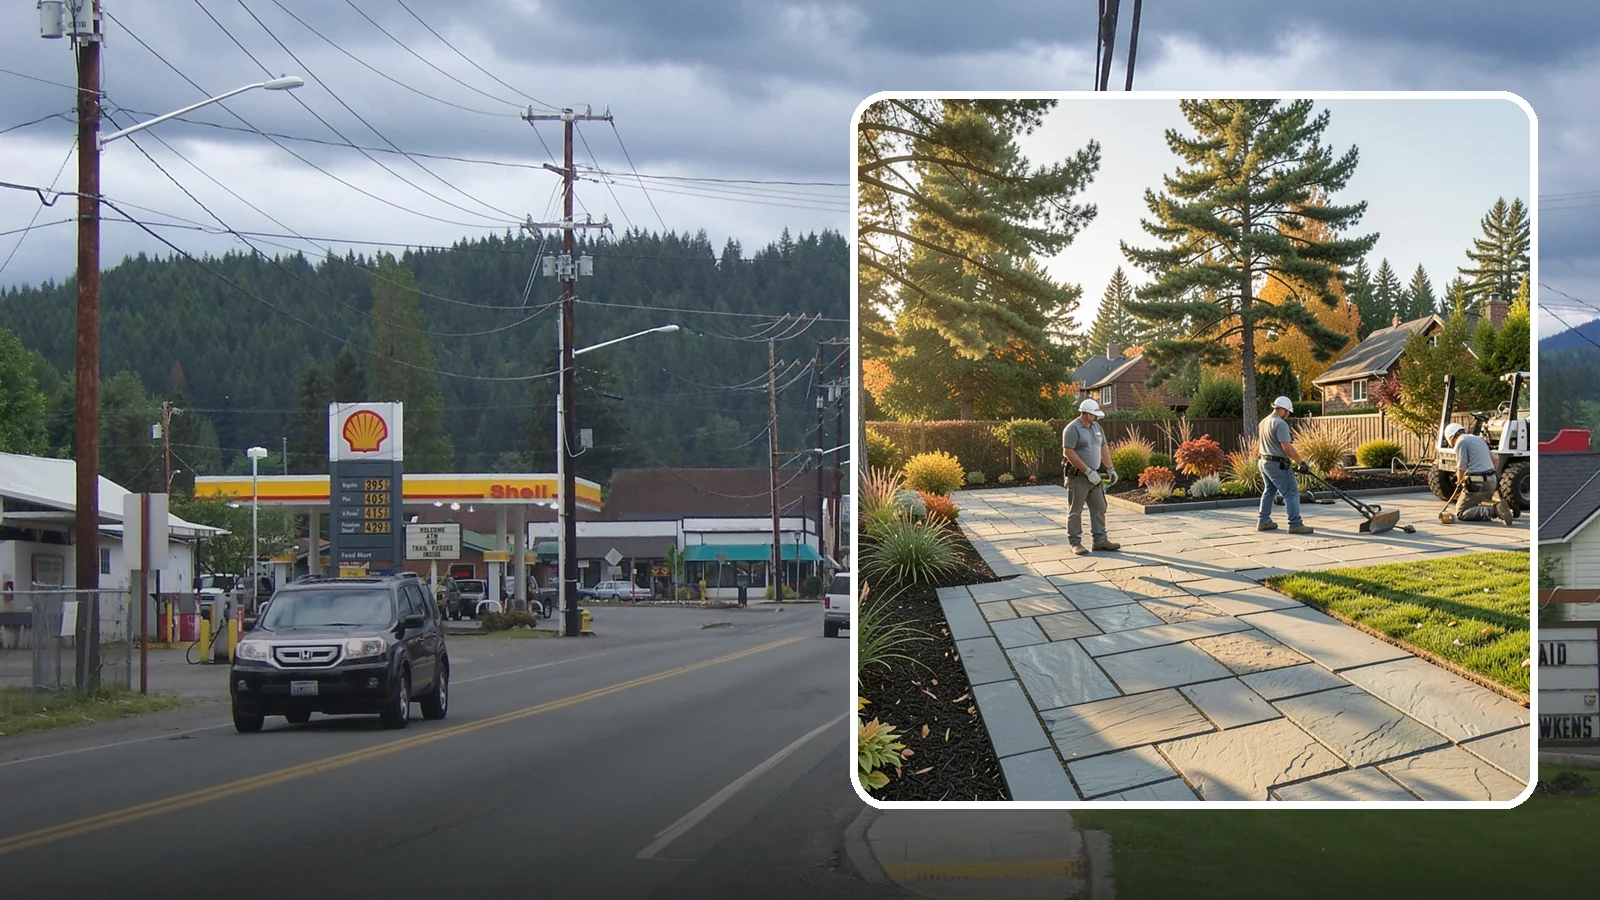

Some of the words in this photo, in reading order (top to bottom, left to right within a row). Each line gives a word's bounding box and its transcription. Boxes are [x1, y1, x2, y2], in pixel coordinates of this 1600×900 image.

[365, 480, 384, 490] 395
[490, 484, 547, 499] Shell
[365, 494, 384, 504] 405
[365, 508, 384, 518] 415
[365, 522, 384, 532] 429
[1539, 642, 1567, 666] AID
